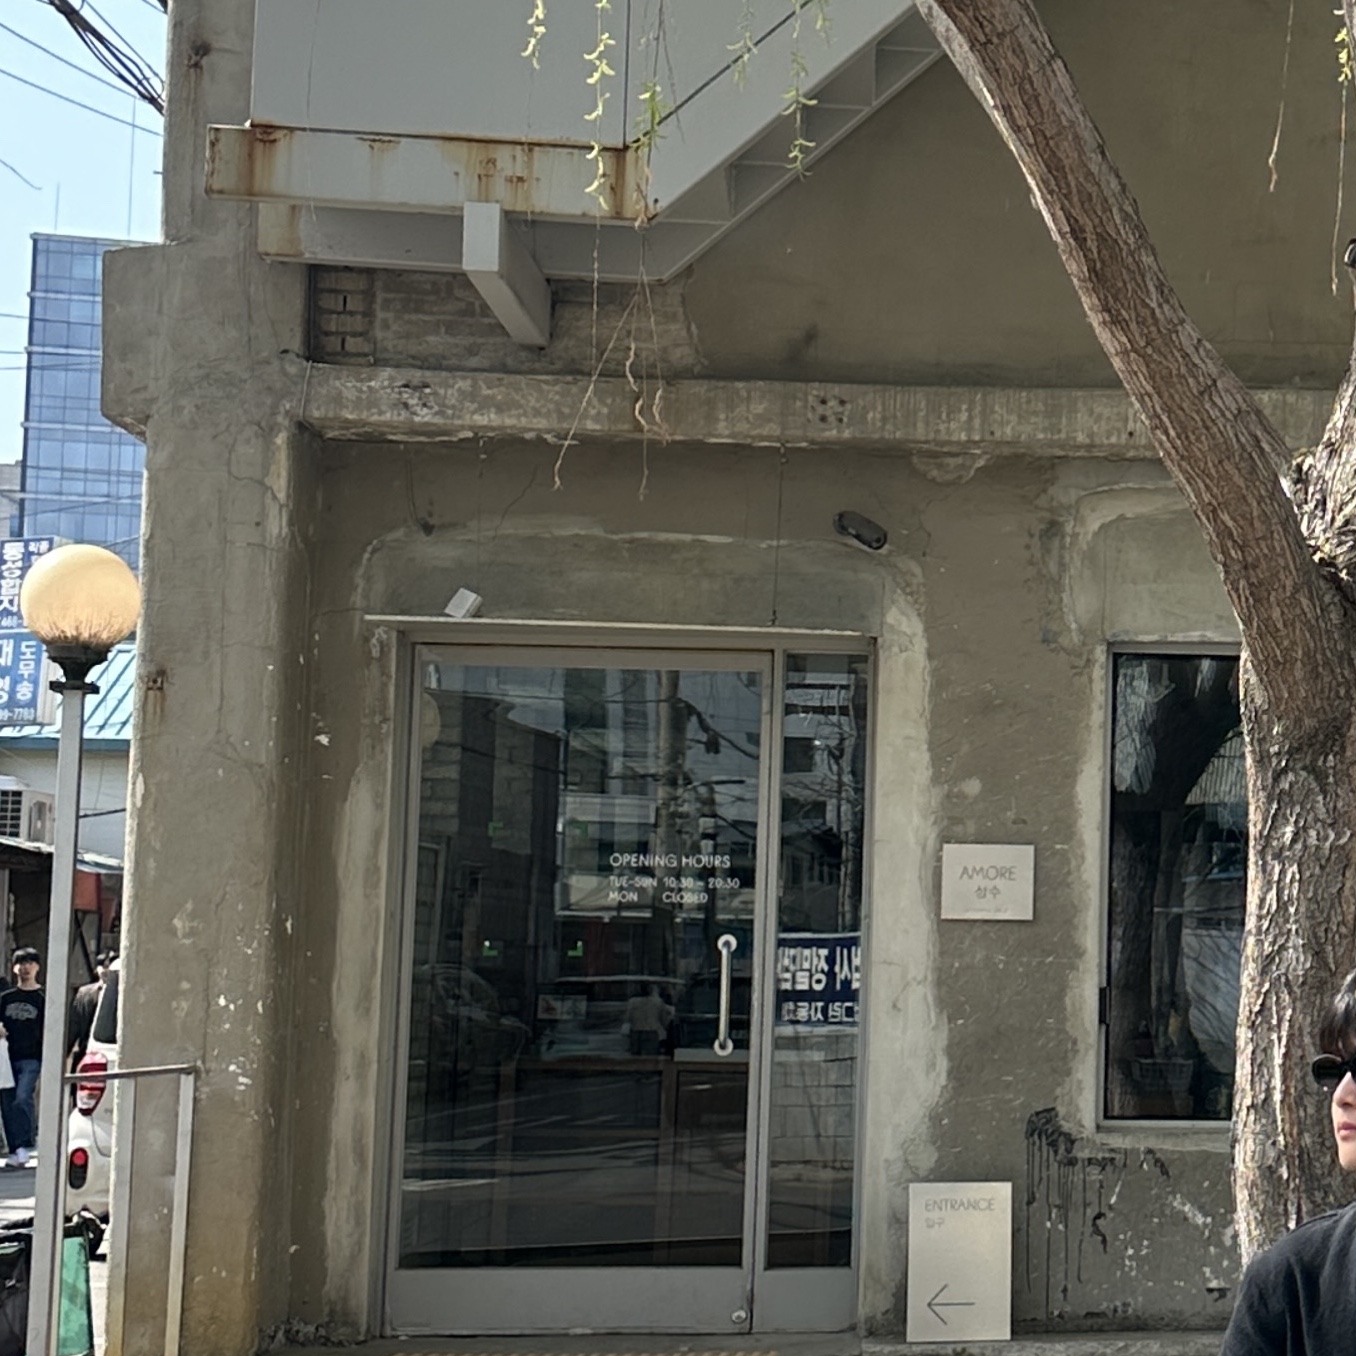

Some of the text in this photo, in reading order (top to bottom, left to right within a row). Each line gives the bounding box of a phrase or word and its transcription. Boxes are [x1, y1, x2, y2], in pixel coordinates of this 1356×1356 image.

[16, 640, 37, 701] 도무송
[609, 853, 731, 868] OPENING HOURS
[959, 865, 1017, 881] AMORE
[707, 877, 740, 889] 20:30
[607, 890, 708, 903] MON CLOSED
[974, 885, 1001, 899] 성수
[924, 1198, 995, 1212] ENTRANCE
